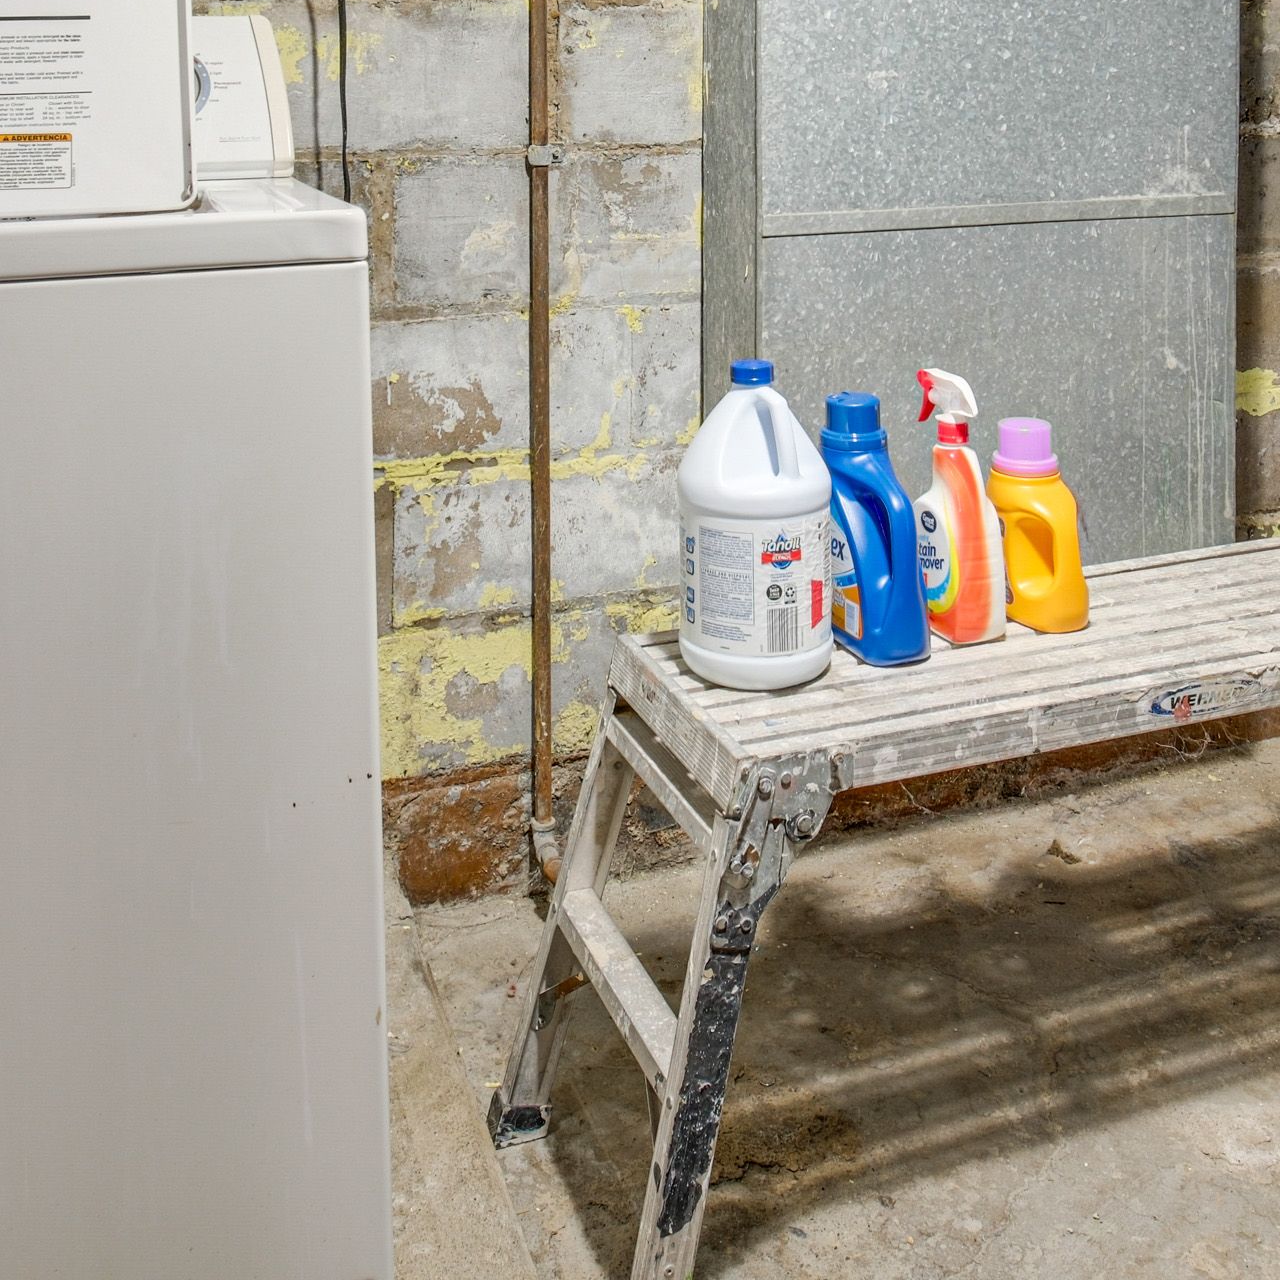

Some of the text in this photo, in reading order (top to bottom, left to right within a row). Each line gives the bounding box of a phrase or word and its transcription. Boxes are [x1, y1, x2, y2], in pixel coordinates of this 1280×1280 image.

[831, 538, 845, 561] ex
[918, 542, 936, 557] tain
[920, 557, 945, 570] mover
